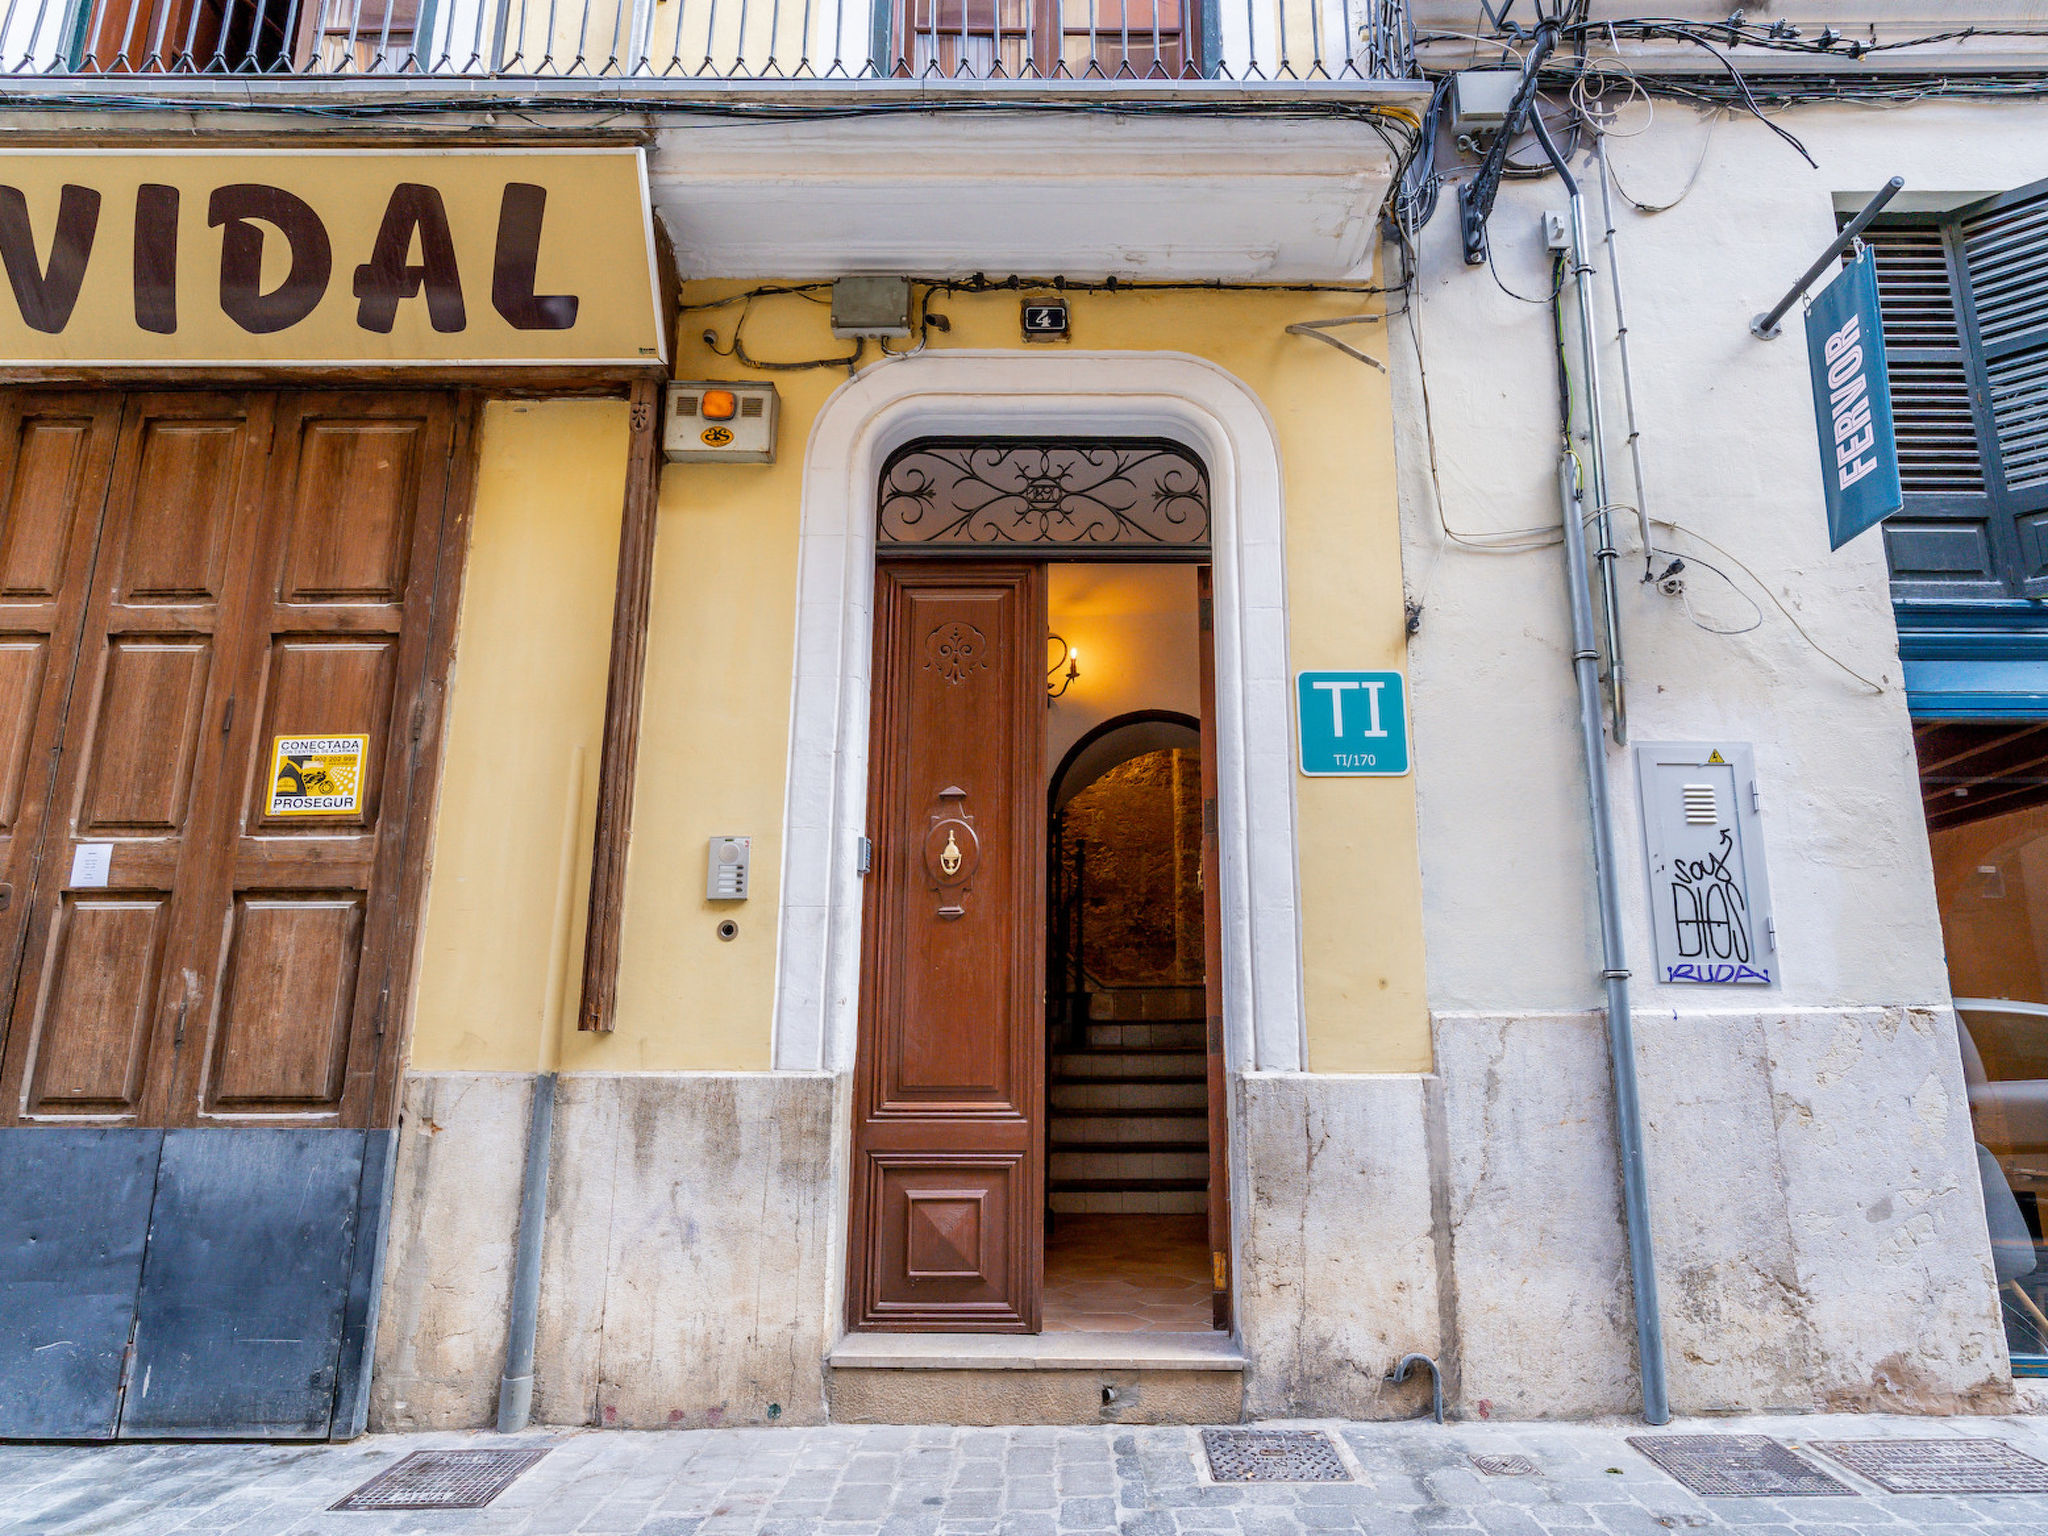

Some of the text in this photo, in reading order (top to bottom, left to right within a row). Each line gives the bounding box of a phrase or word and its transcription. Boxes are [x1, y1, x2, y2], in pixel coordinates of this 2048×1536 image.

[0, 182, 579, 335] VIDAL
[1036, 309, 1051, 328] 4
[1824, 313, 1878, 492] FERVOR
[1312, 681, 1388, 738] TI
[281, 740, 359, 750] CONECTADA
[1333, 753, 1376, 768] TI/170
[273, 797, 354, 809] PROSEGUR
